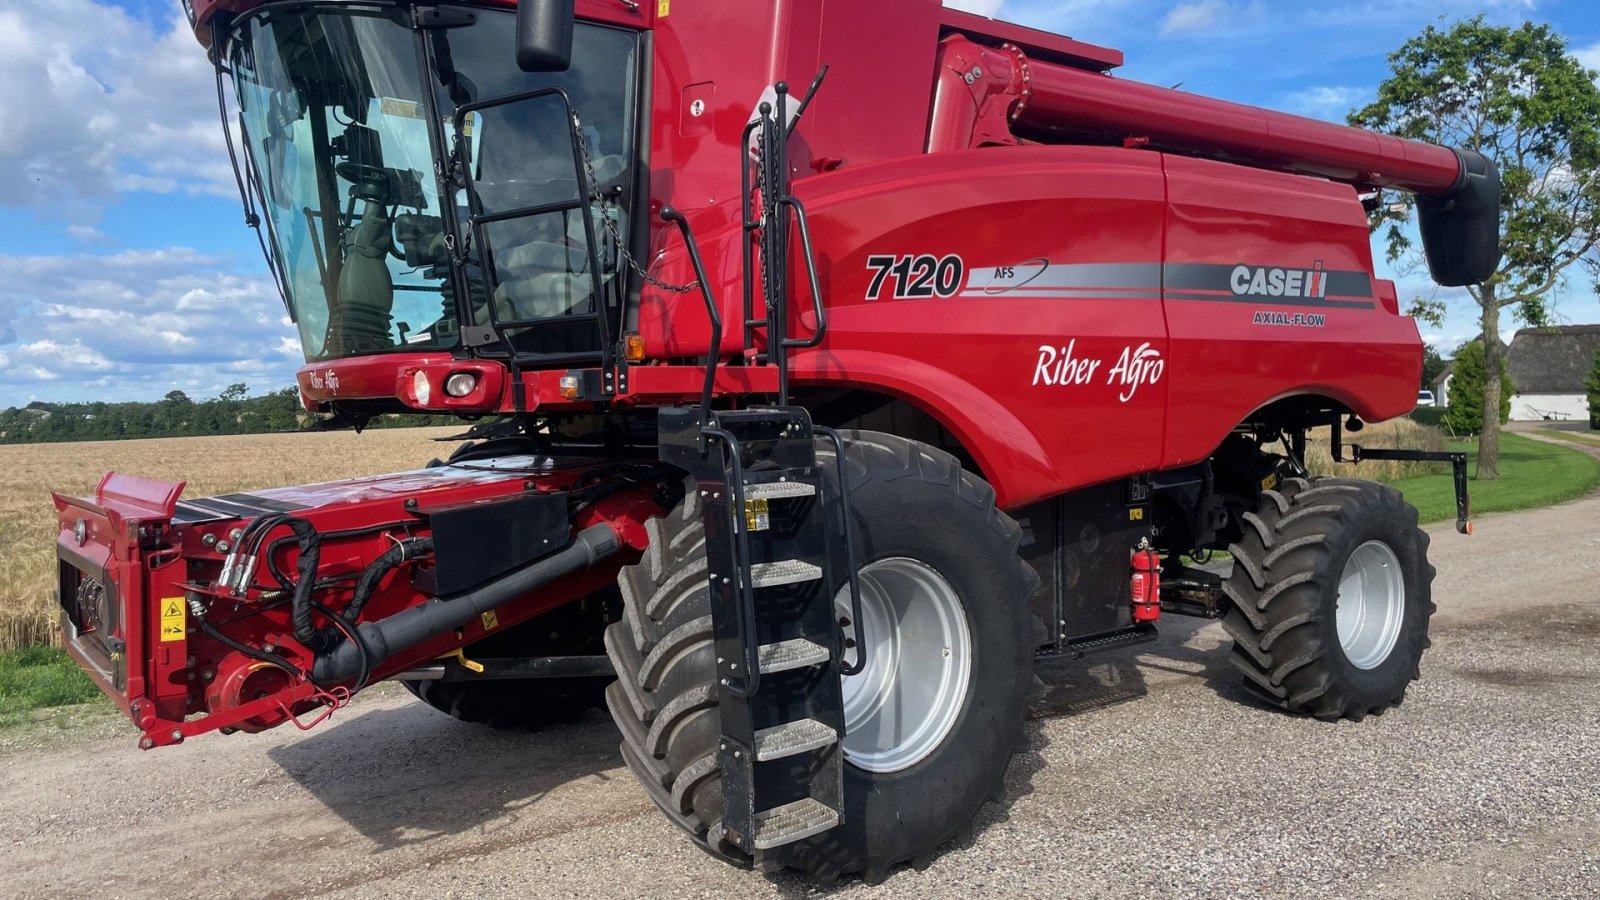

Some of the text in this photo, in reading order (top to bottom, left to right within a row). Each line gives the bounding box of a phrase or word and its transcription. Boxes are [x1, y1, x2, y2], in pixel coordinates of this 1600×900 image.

[865, 253, 963, 300] 7120
[994, 267, 1014, 279] AFS
[1230, 265, 1303, 297] CASE
[1253, 311, 1325, 327] AXIAL-FLOW
[1032, 338, 1164, 402] Riber Agro
